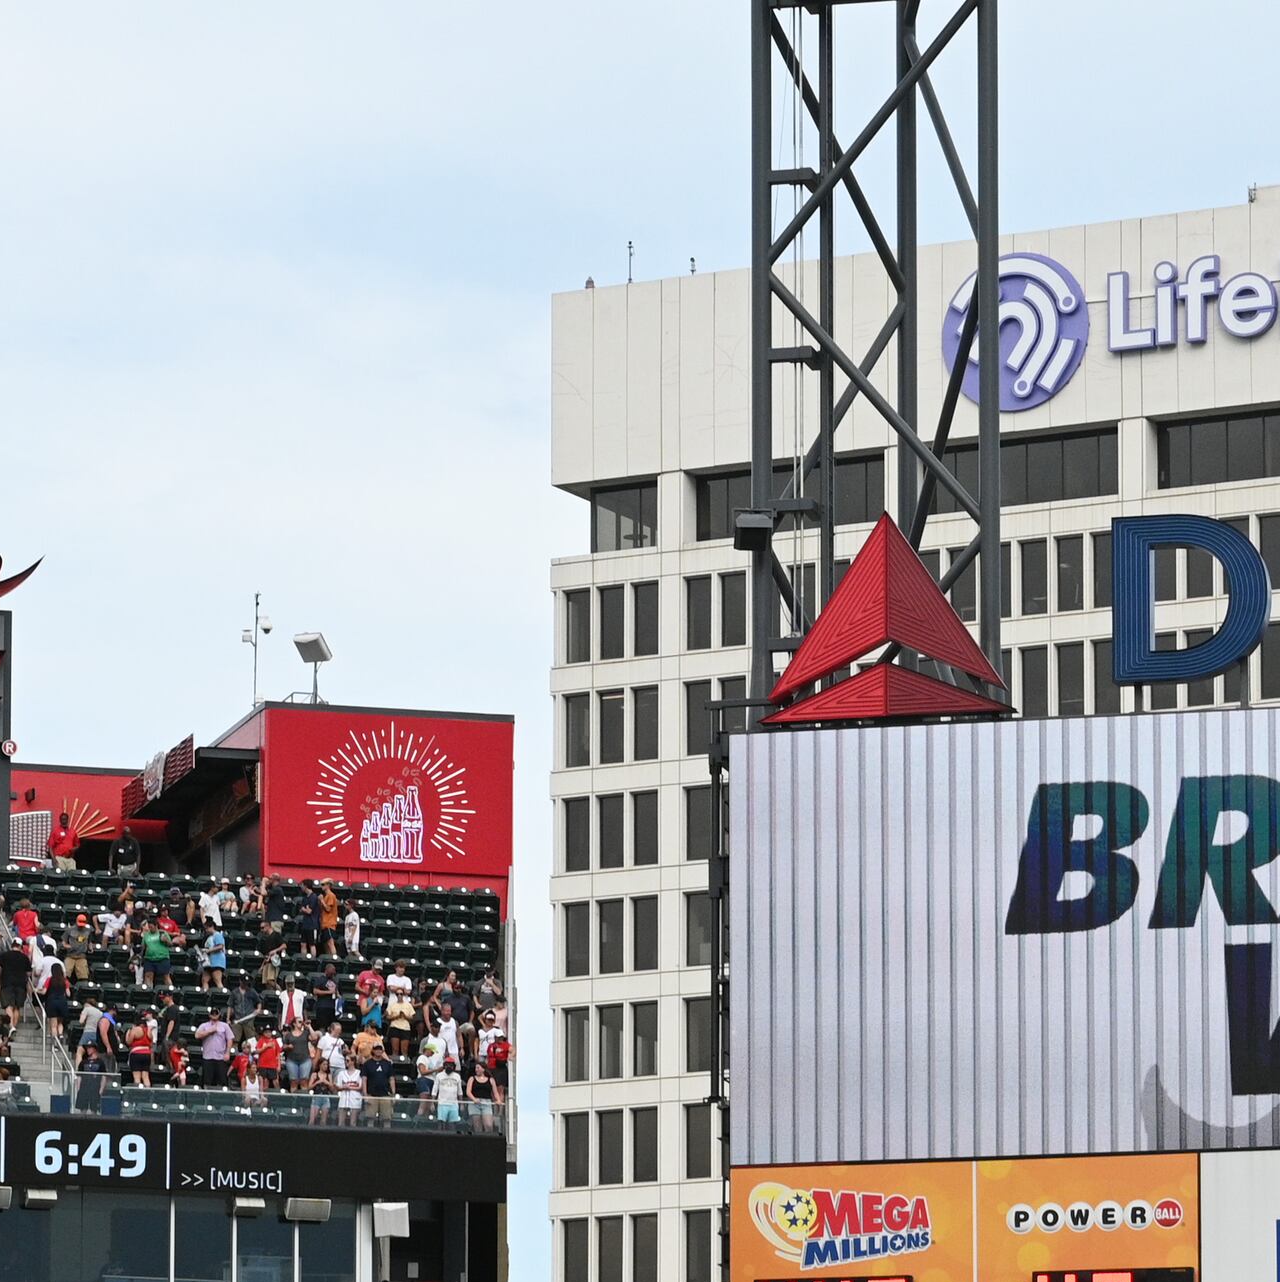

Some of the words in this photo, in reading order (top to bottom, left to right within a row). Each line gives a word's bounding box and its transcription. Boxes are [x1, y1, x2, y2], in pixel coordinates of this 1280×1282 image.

[34, 1129, 148, 1179] 6:49
[210, 1167, 282, 1193] [MUSIC]
[809, 1188, 932, 1240] MEGA
[803, 1231, 931, 1269] MILLIONS
